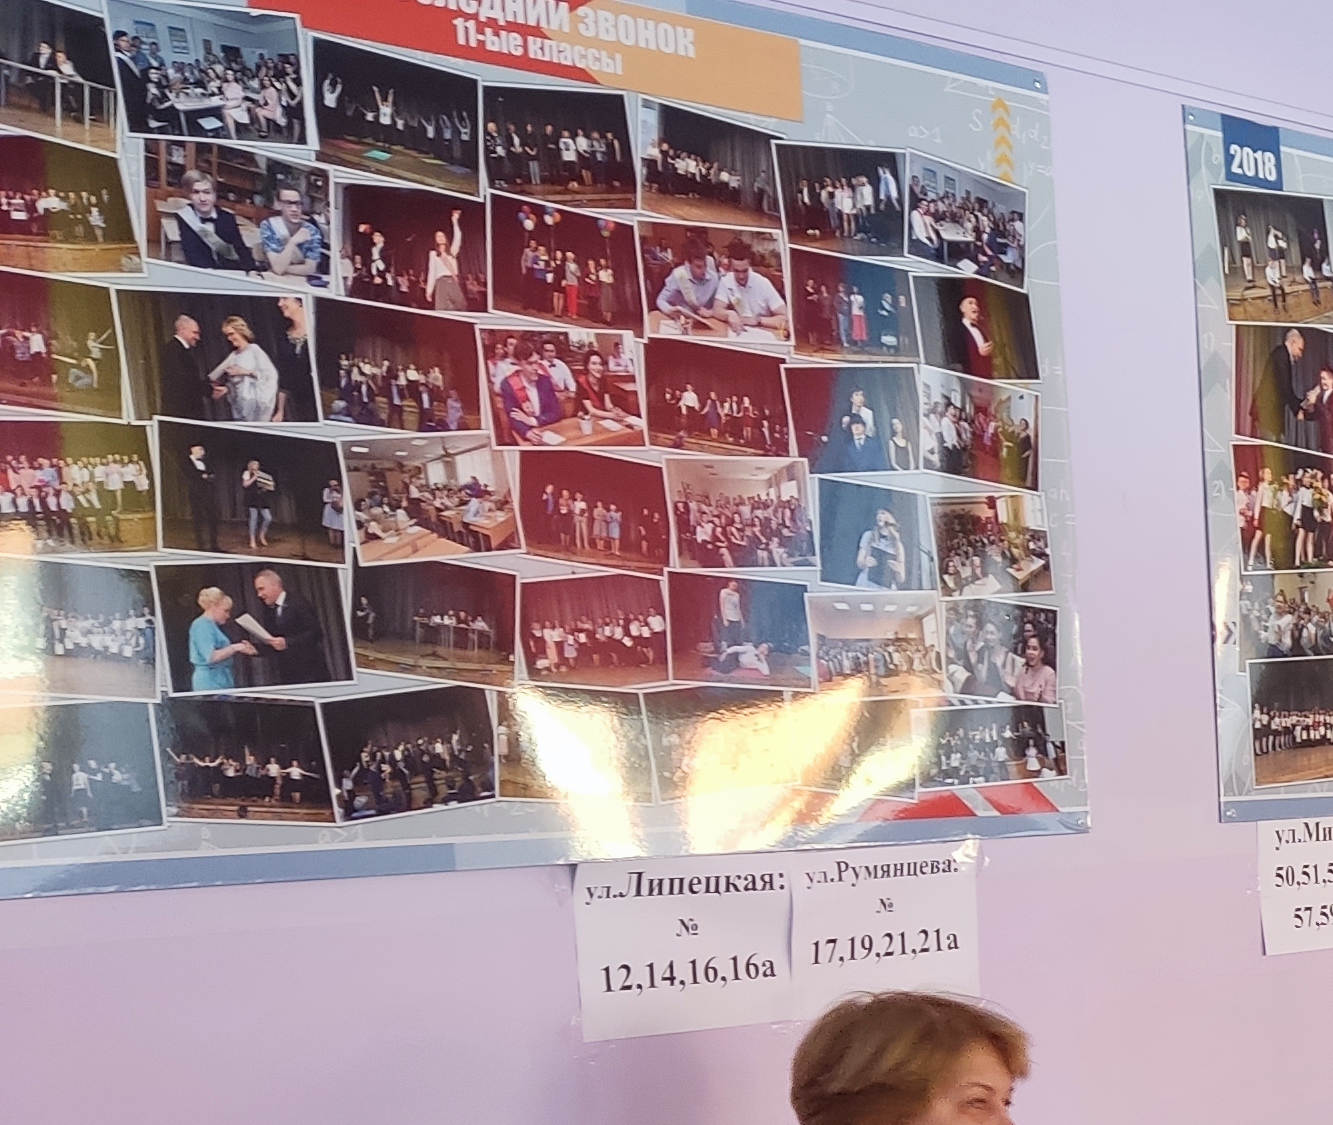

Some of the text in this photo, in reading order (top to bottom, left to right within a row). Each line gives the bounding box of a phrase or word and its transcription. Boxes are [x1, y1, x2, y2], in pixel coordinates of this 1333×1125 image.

[452, 17, 623, 75] 11-ые классы
[1229, 143, 1277, 182] 2018
[585, 870, 786, 905] ул.Липецкая:
[804, 857, 960, 890] ул.Румянцева:
[875, 897, 895, 914] №
[676, 918, 700, 937] №
[811, 928, 960, 966] 17,19,21,21а
[600, 953, 777, 995] 12,14,16,16а
